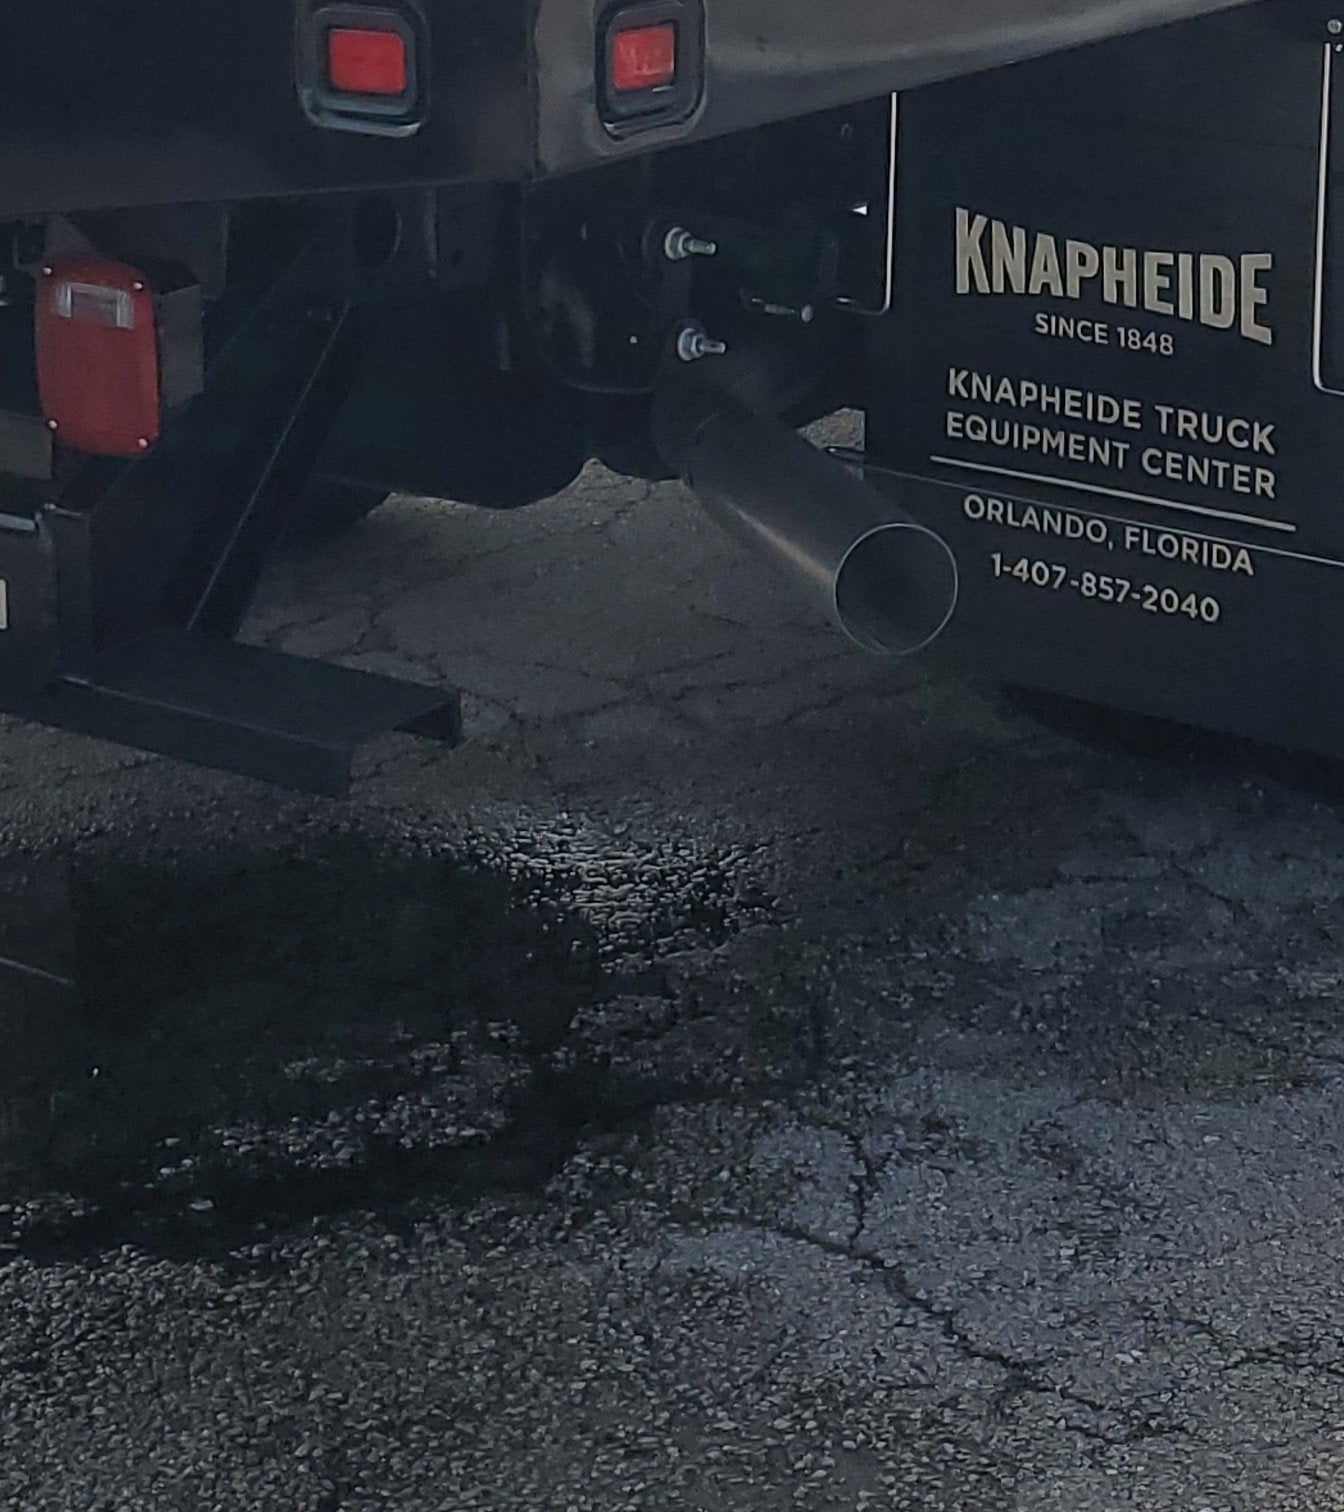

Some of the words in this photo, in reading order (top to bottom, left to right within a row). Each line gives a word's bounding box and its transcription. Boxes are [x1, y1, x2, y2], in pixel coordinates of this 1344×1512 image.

[956, 206, 1272, 346] KNAPHEIDE
[1035, 312, 1109, 345] SINCE
[1117, 325, 1174, 356] 1848
[948, 367, 1142, 430] KNAPHEIDE
[1155, 404, 1276, 455] TRUCK
[946, 411, 1130, 469] EQUIPMENT
[1142, 448, 1276, 499] CENTER
[963, 494, 1115, 550] ORLANDO,
[1124, 526, 1254, 576] FLORIDA
[991, 552, 1220, 623] 1-407-857-2040
